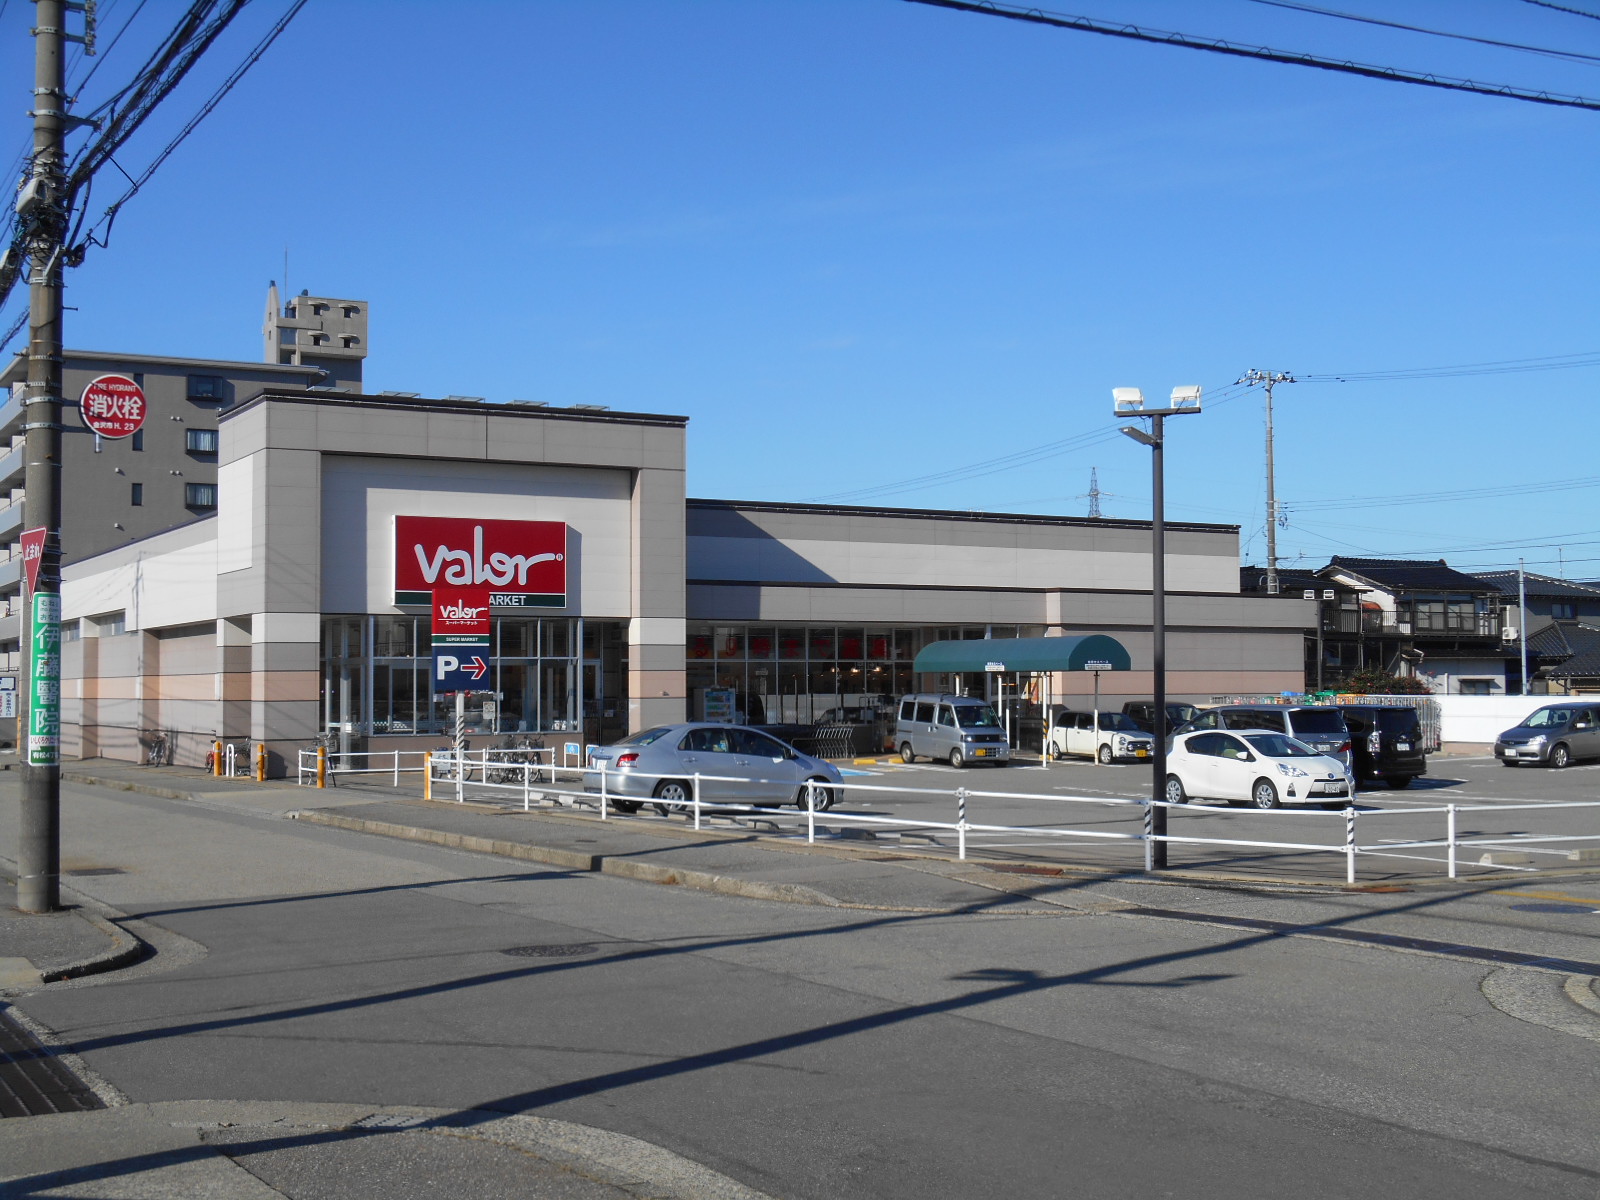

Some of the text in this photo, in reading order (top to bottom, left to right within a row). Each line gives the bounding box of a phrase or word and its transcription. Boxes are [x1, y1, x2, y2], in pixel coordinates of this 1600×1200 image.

[108, 384, 136, 392] HYDRANT
[89, 393, 142, 419] 消火栓
[93, 421, 113, 429] 金沢市
[124, 422, 135, 431] 23
[24, 542, 42, 561] 止まれ
[488, 595, 527, 606] ARKET
[437, 655, 459, 680] P
